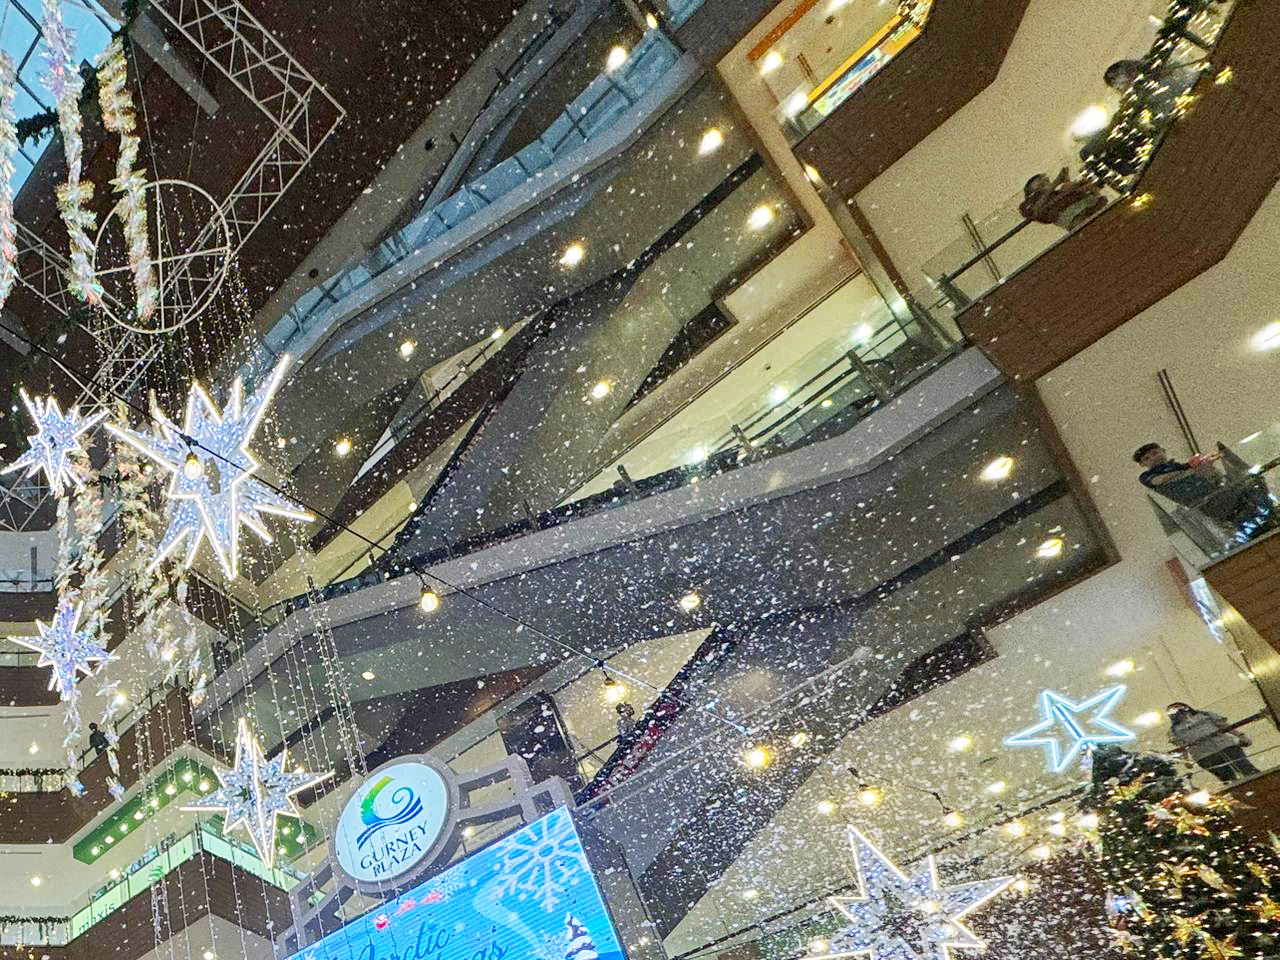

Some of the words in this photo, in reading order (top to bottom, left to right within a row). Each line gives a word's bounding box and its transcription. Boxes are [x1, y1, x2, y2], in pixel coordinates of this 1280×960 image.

[360, 820, 428, 869] GURNEY
[372, 842, 422, 877] PLAZA
[78, 902, 116, 934] maxis
